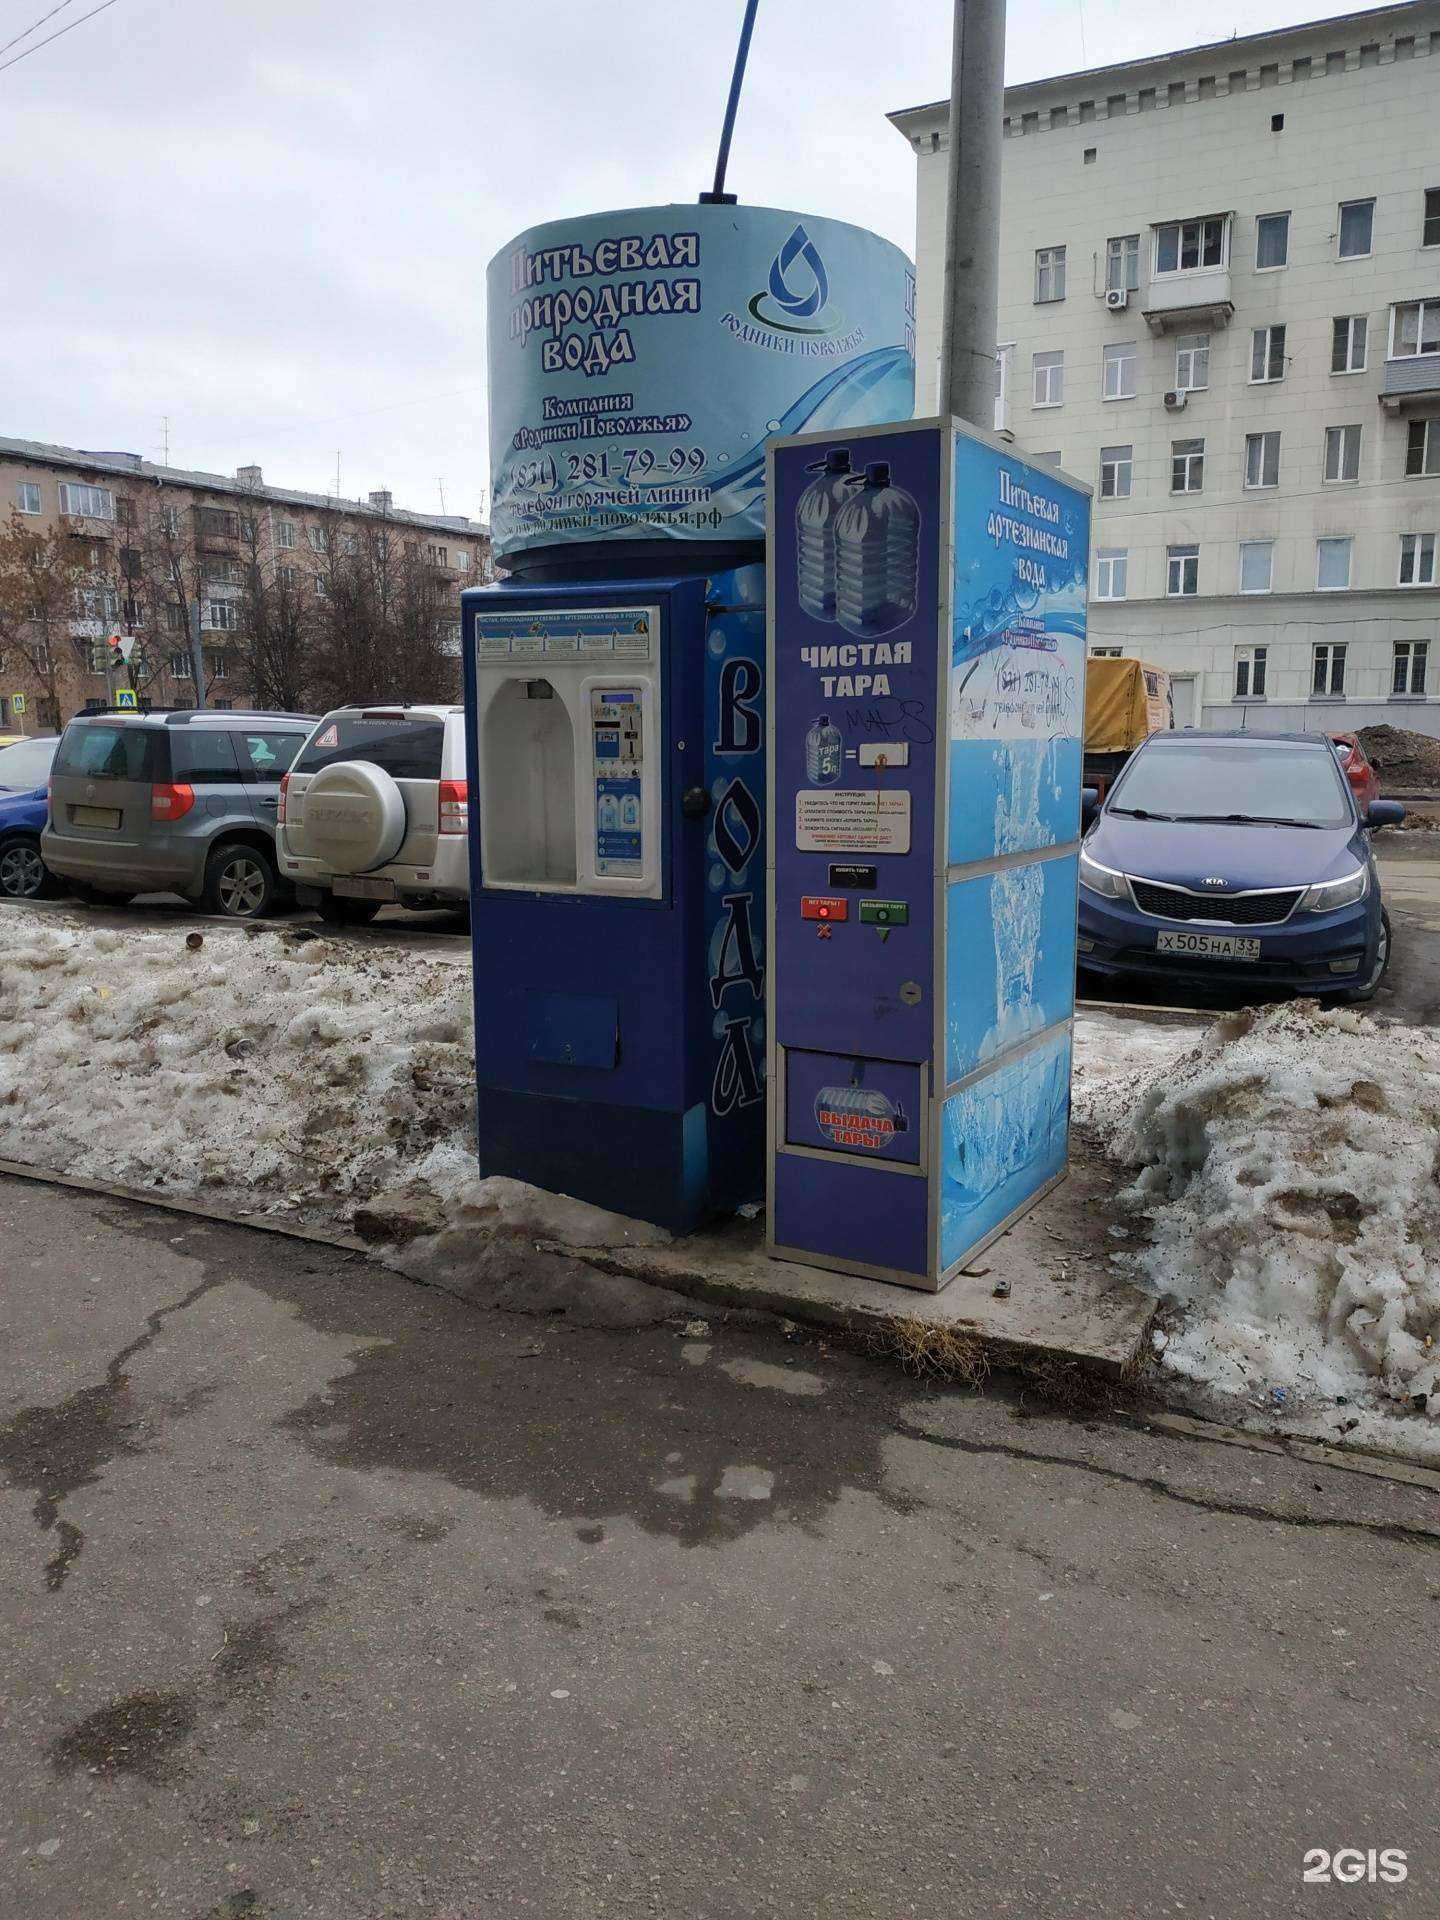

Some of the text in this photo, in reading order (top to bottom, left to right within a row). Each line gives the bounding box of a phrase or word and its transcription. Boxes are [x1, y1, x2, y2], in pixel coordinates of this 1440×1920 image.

[510, 233, 700, 295] Питьевая
[509, 279, 700, 347] природная
[720, 312, 795, 354] РОДНИКИ
[543, 329, 636, 376] вода
[543, 393, 633, 420] Компания
[513, 414, 692, 450] «Родники Поволжья»
[511, 447, 707, 491] (831) 281-79-99
[510, 483, 711, 518] телефон горячей линии
[999, 469, 1059, 524] Питьевая
[987, 511, 1068, 560] артезианская
[1018, 557, 1046, 590] вода
[800, 641, 912, 668] ЧИСТАЯ
[820, 674, 891, 698] ТАРА
[819, 744, 840, 756] тара
[709, 656, 764, 1116] ВОДА
[1237, 938, 1254, 951] 33
[819, 1110, 895, 1132] ВЫДАЧА
[833, 1129, 881, 1148] ТАРЫ
